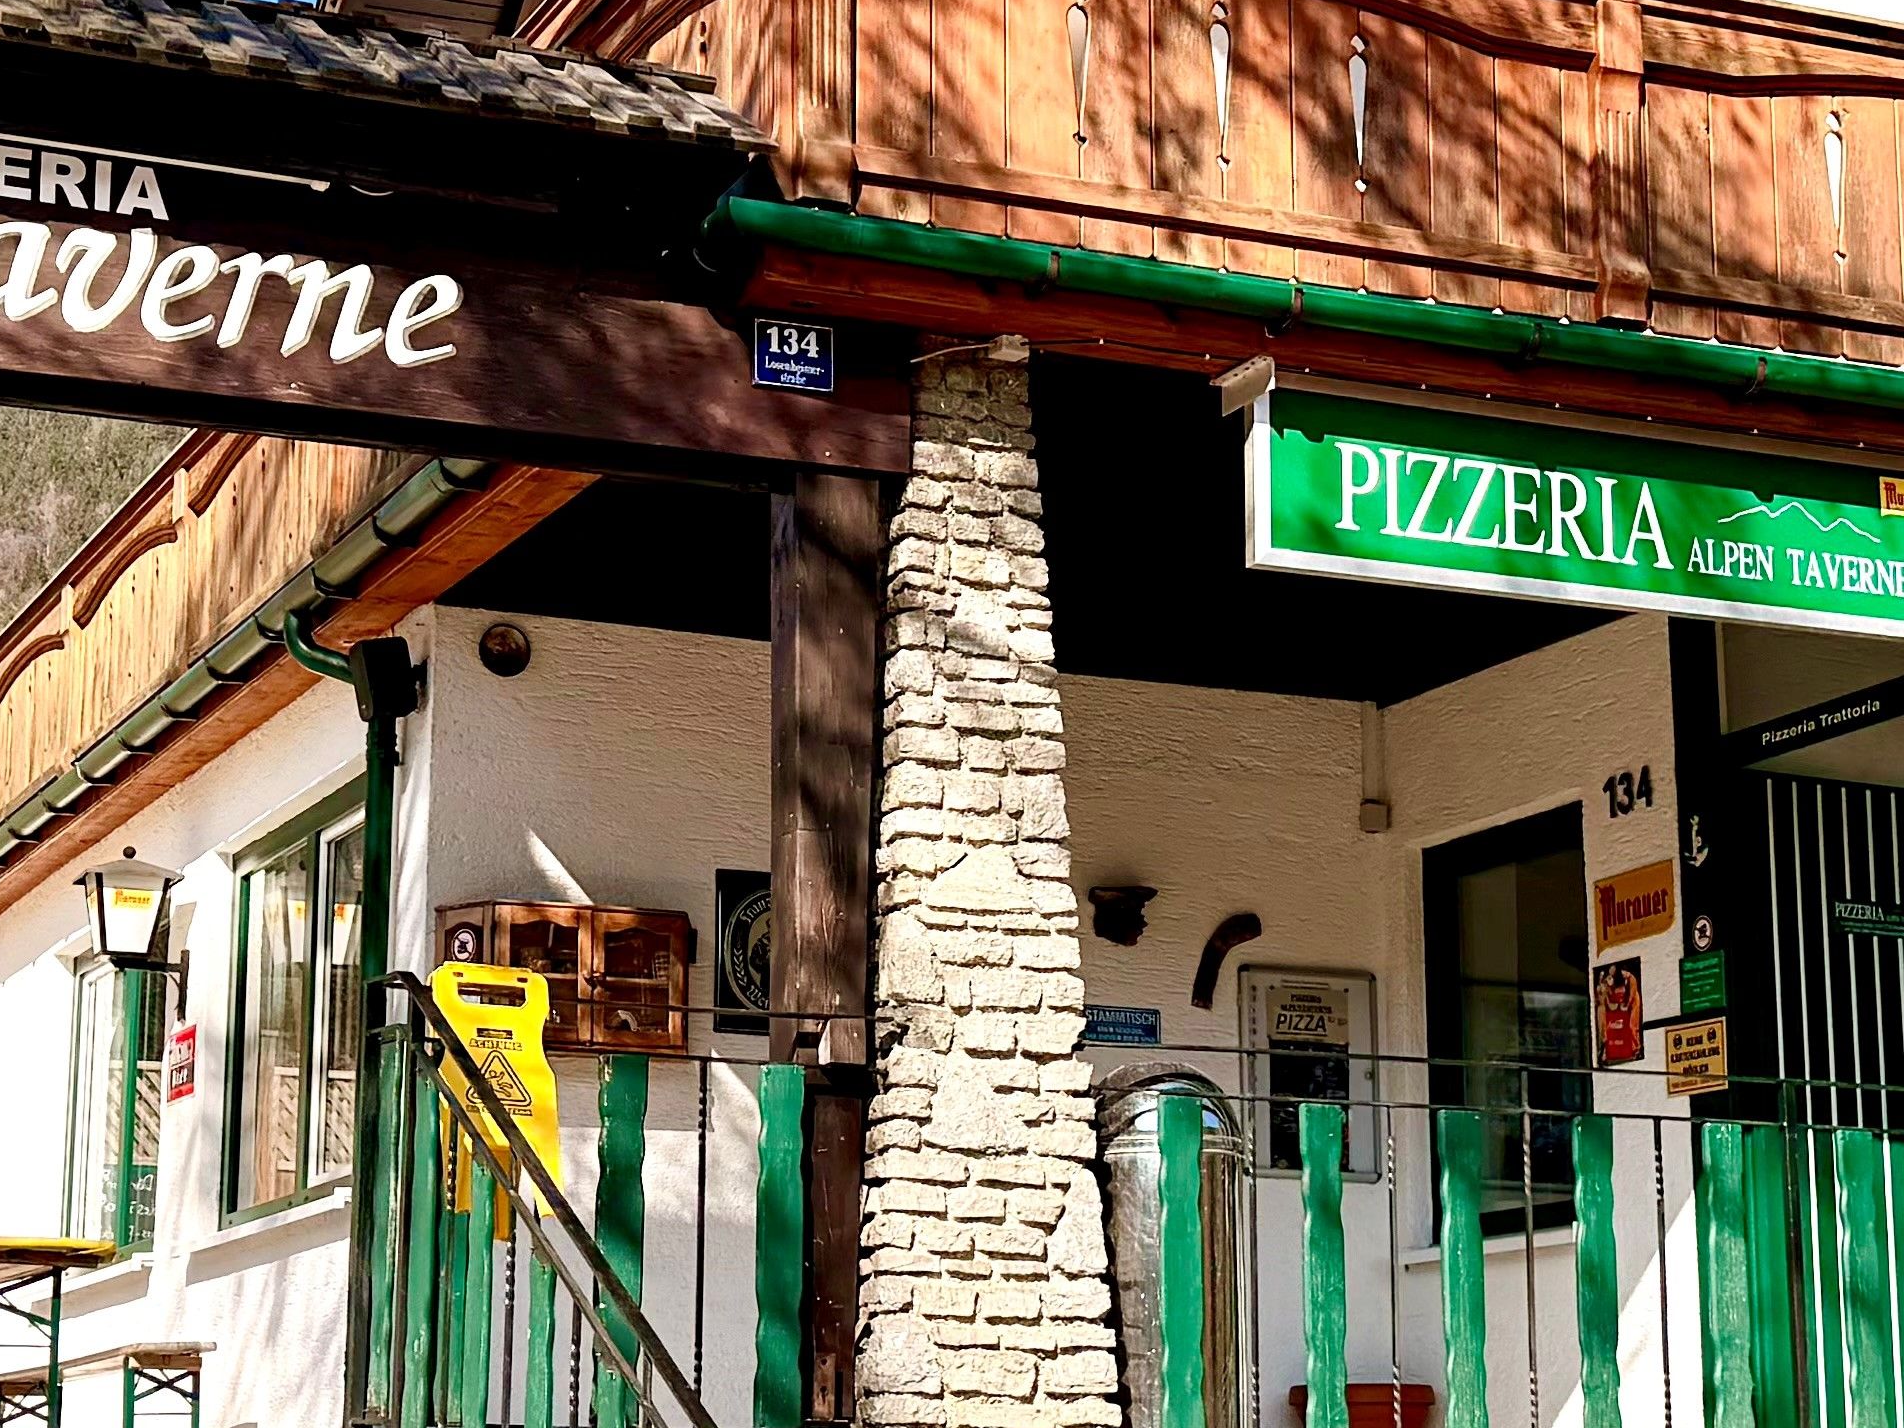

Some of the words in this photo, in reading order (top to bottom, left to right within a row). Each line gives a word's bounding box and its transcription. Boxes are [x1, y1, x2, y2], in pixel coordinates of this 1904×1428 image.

[766, 326, 820, 358] 134
[1333, 441, 1675, 571] PIZZERIA
[1687, 536, 1774, 583] ALPEN
[1762, 719, 1816, 746] Pizzeria
[1819, 699, 1880, 727] Trattoria
[1602, 766, 1654, 819] 134
[1595, 883, 1669, 942] Murauer
[1835, 901, 1885, 921] PIZZERIA
[1275, 1013, 1328, 1033] PIZZA
